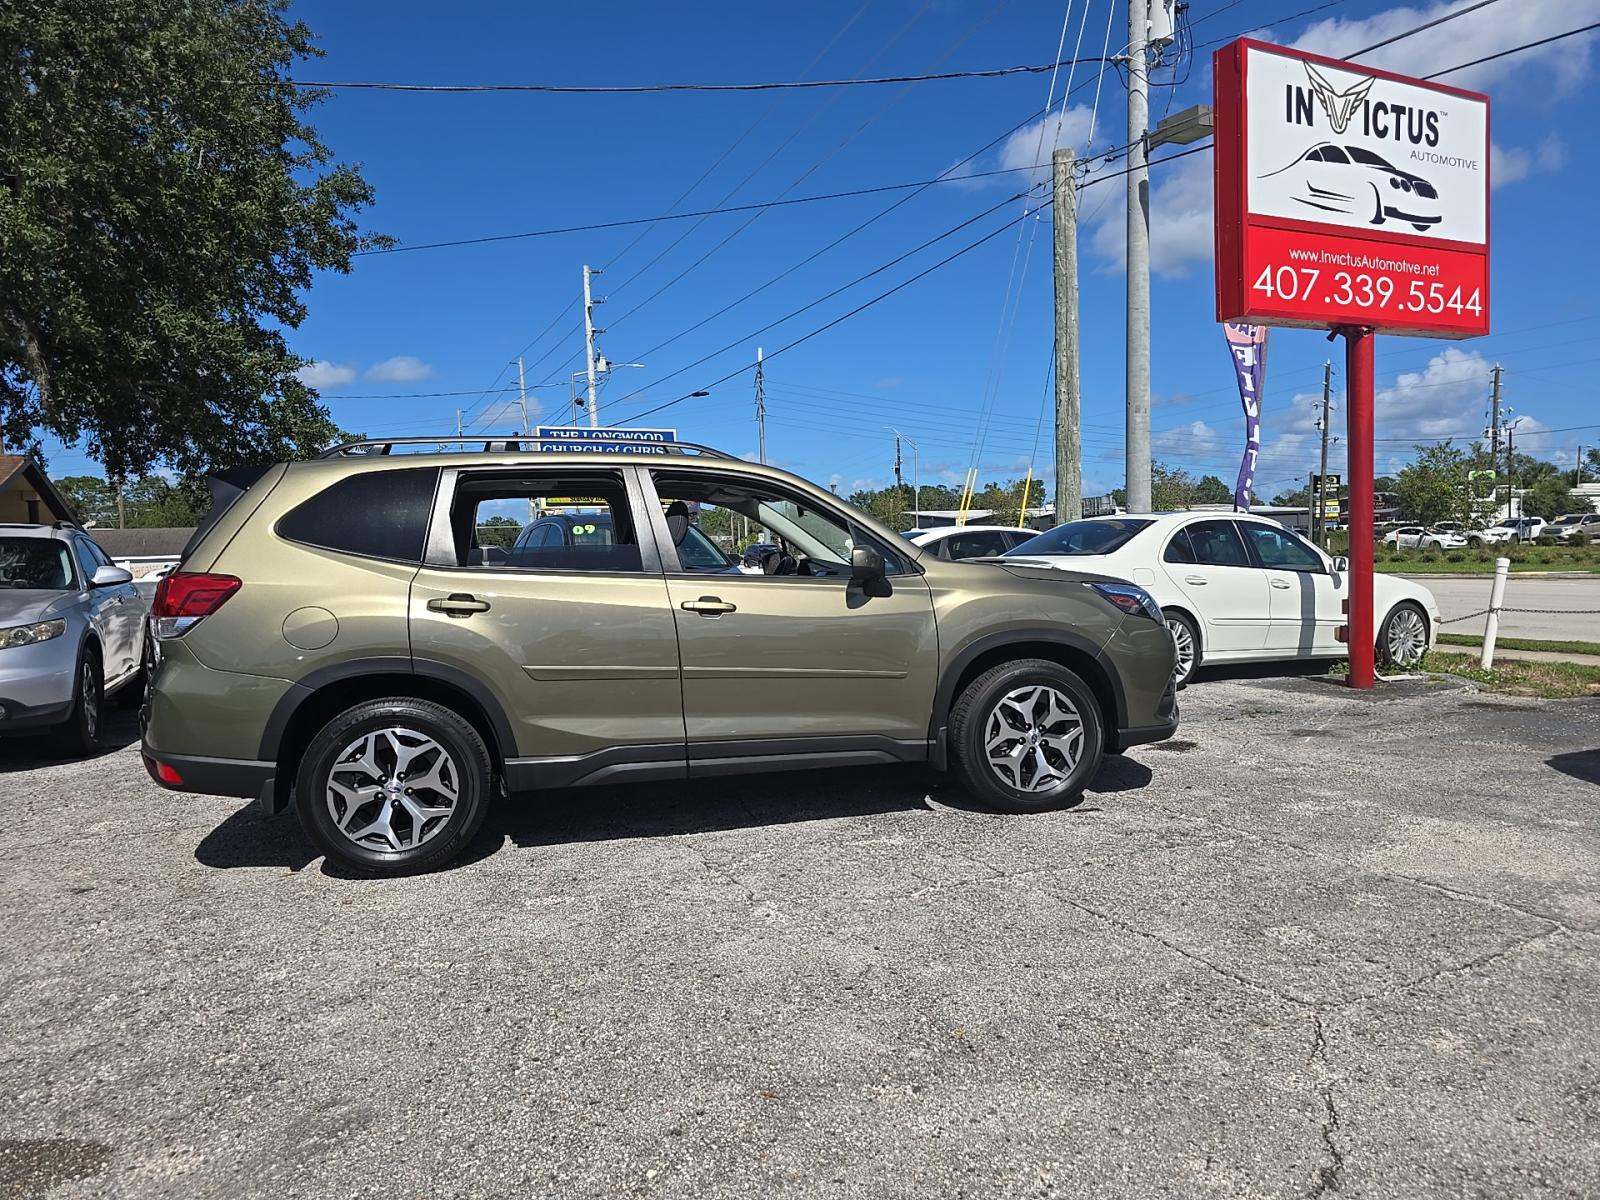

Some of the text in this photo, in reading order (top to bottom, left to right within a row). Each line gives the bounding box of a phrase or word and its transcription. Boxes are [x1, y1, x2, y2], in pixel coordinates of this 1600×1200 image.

[1410, 150, 1478, 170] AUTOMOTIVE
[1289, 248, 1439, 276] www.InvictusAutomotive.net
[1253, 263, 1483, 317] 407.339.5544
[623, 446, 665, 455] CHRIS
